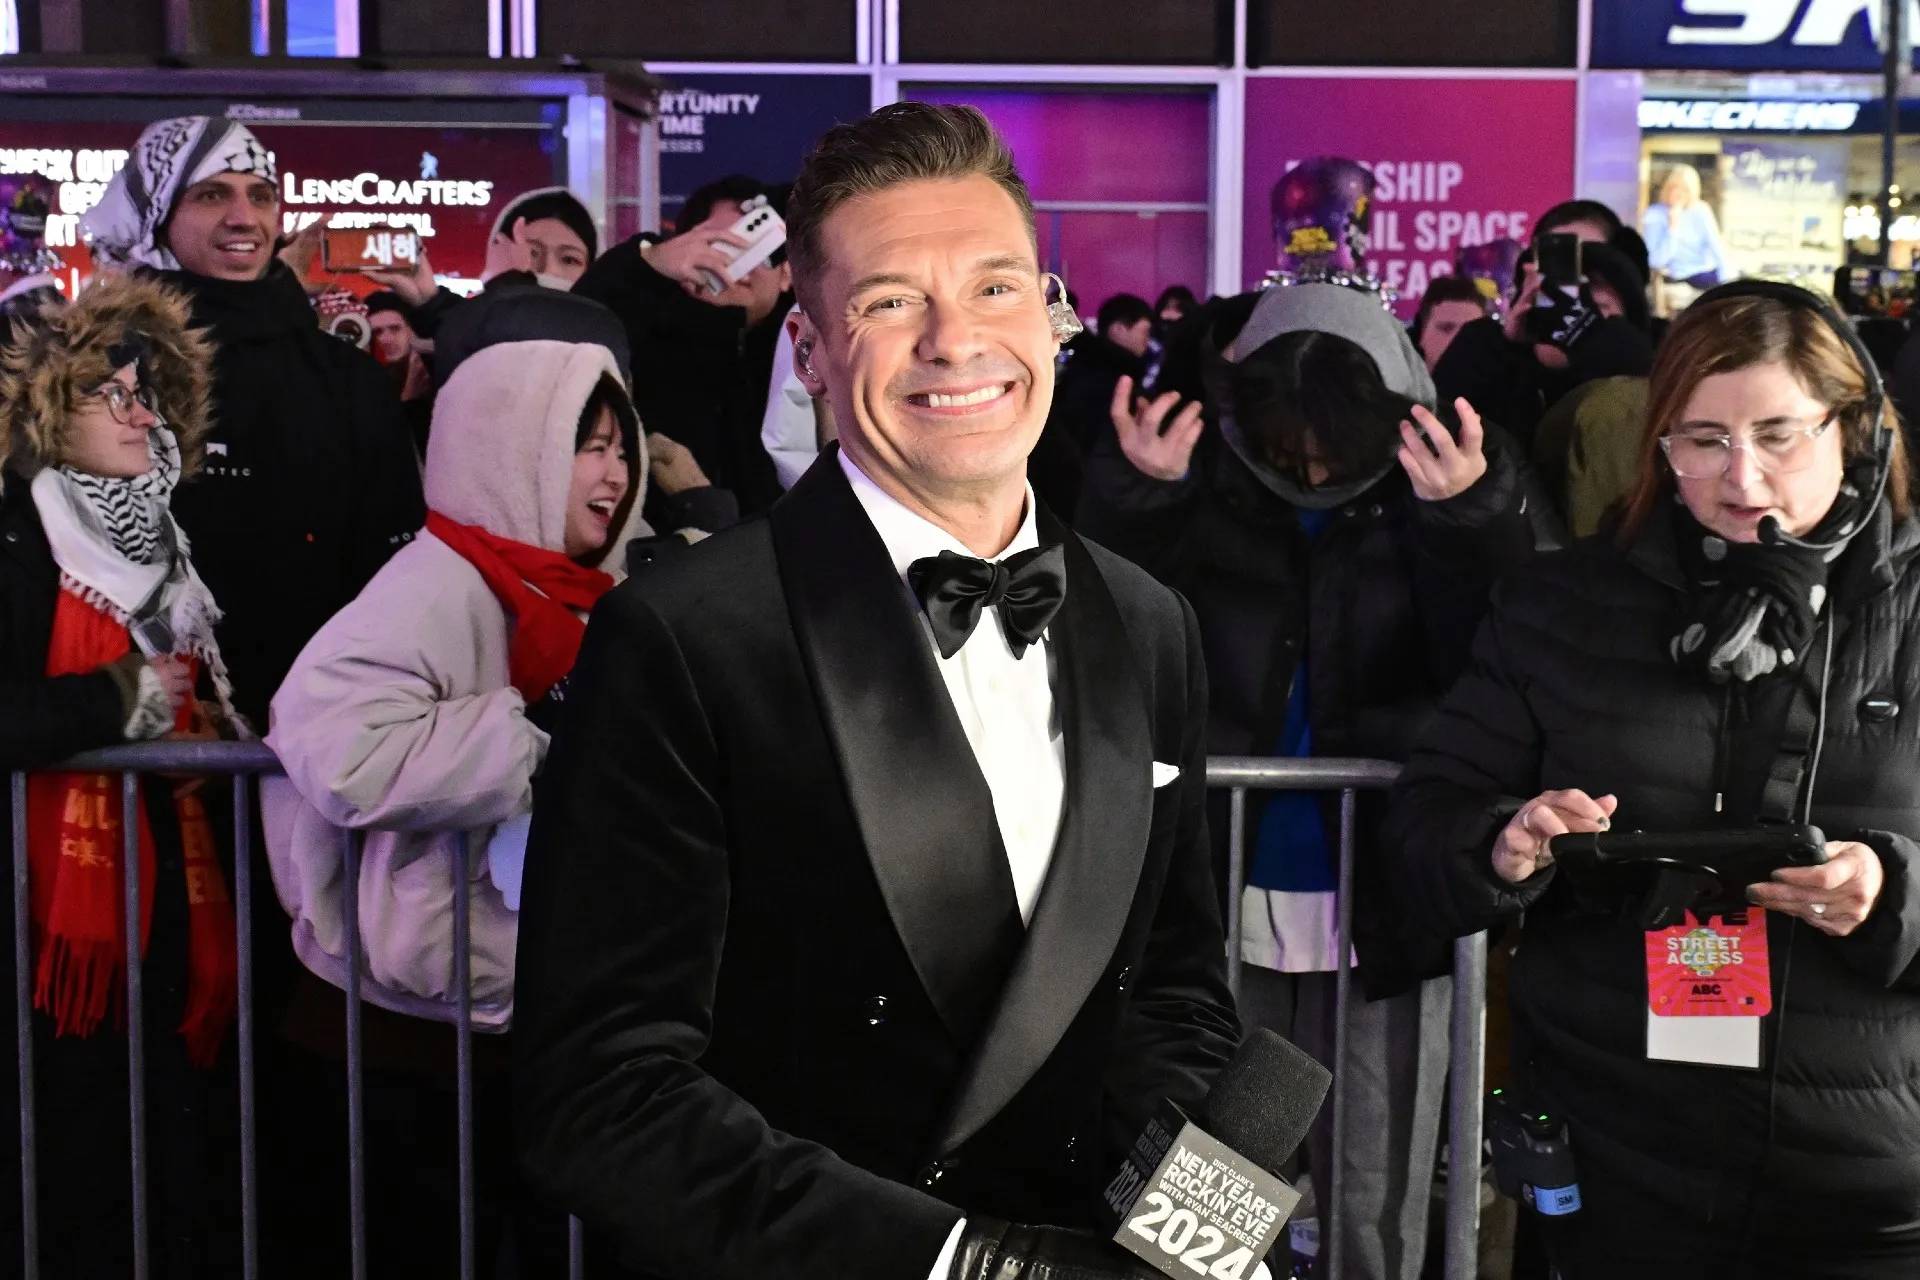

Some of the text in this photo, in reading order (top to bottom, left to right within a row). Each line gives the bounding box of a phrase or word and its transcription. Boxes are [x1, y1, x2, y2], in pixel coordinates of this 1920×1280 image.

[658, 93, 760, 115] RTUNITY
[1666, 936, 1741, 951] STREET
[1666, 951, 1744, 965] ACCESS
[1691, 984, 1722, 996] ABC
[1173, 1145, 1220, 1185] NEW
[1218, 1173, 1280, 1223] YEAR'S
[1212, 1158, 1256, 1190] DICK CLARK'S
[1158, 1179, 1260, 1250] WITH RYAN SEACREST
[1162, 1162, 1236, 1216] ROCKIN'
[1231, 1206, 1271, 1241] EVE
[1127, 1191, 1255, 1280] 2024
